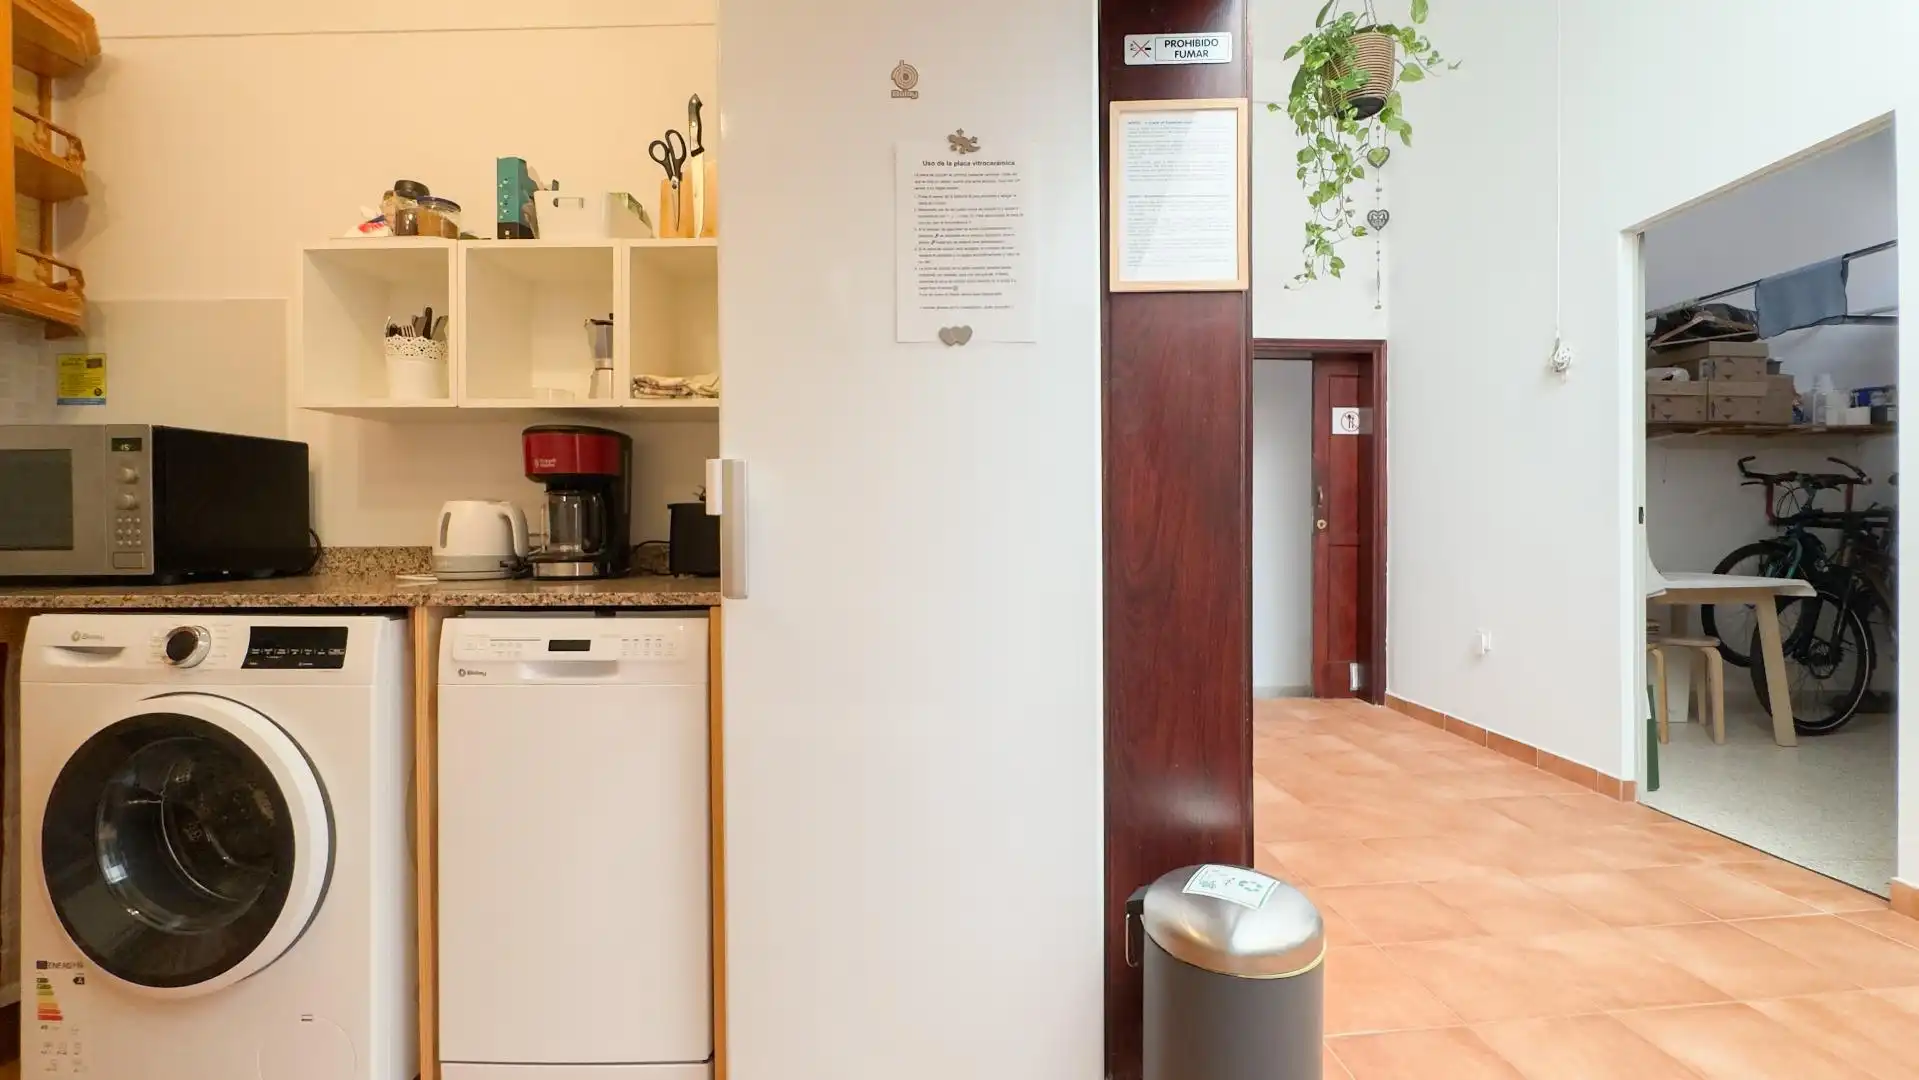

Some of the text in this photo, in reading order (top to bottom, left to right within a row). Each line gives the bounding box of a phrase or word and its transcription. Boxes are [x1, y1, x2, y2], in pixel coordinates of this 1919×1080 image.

[1164, 38, 1219, 48] PROHIBIDO
[1174, 50, 1209, 59] FUMAR
[953, 160, 971, 168] placa
